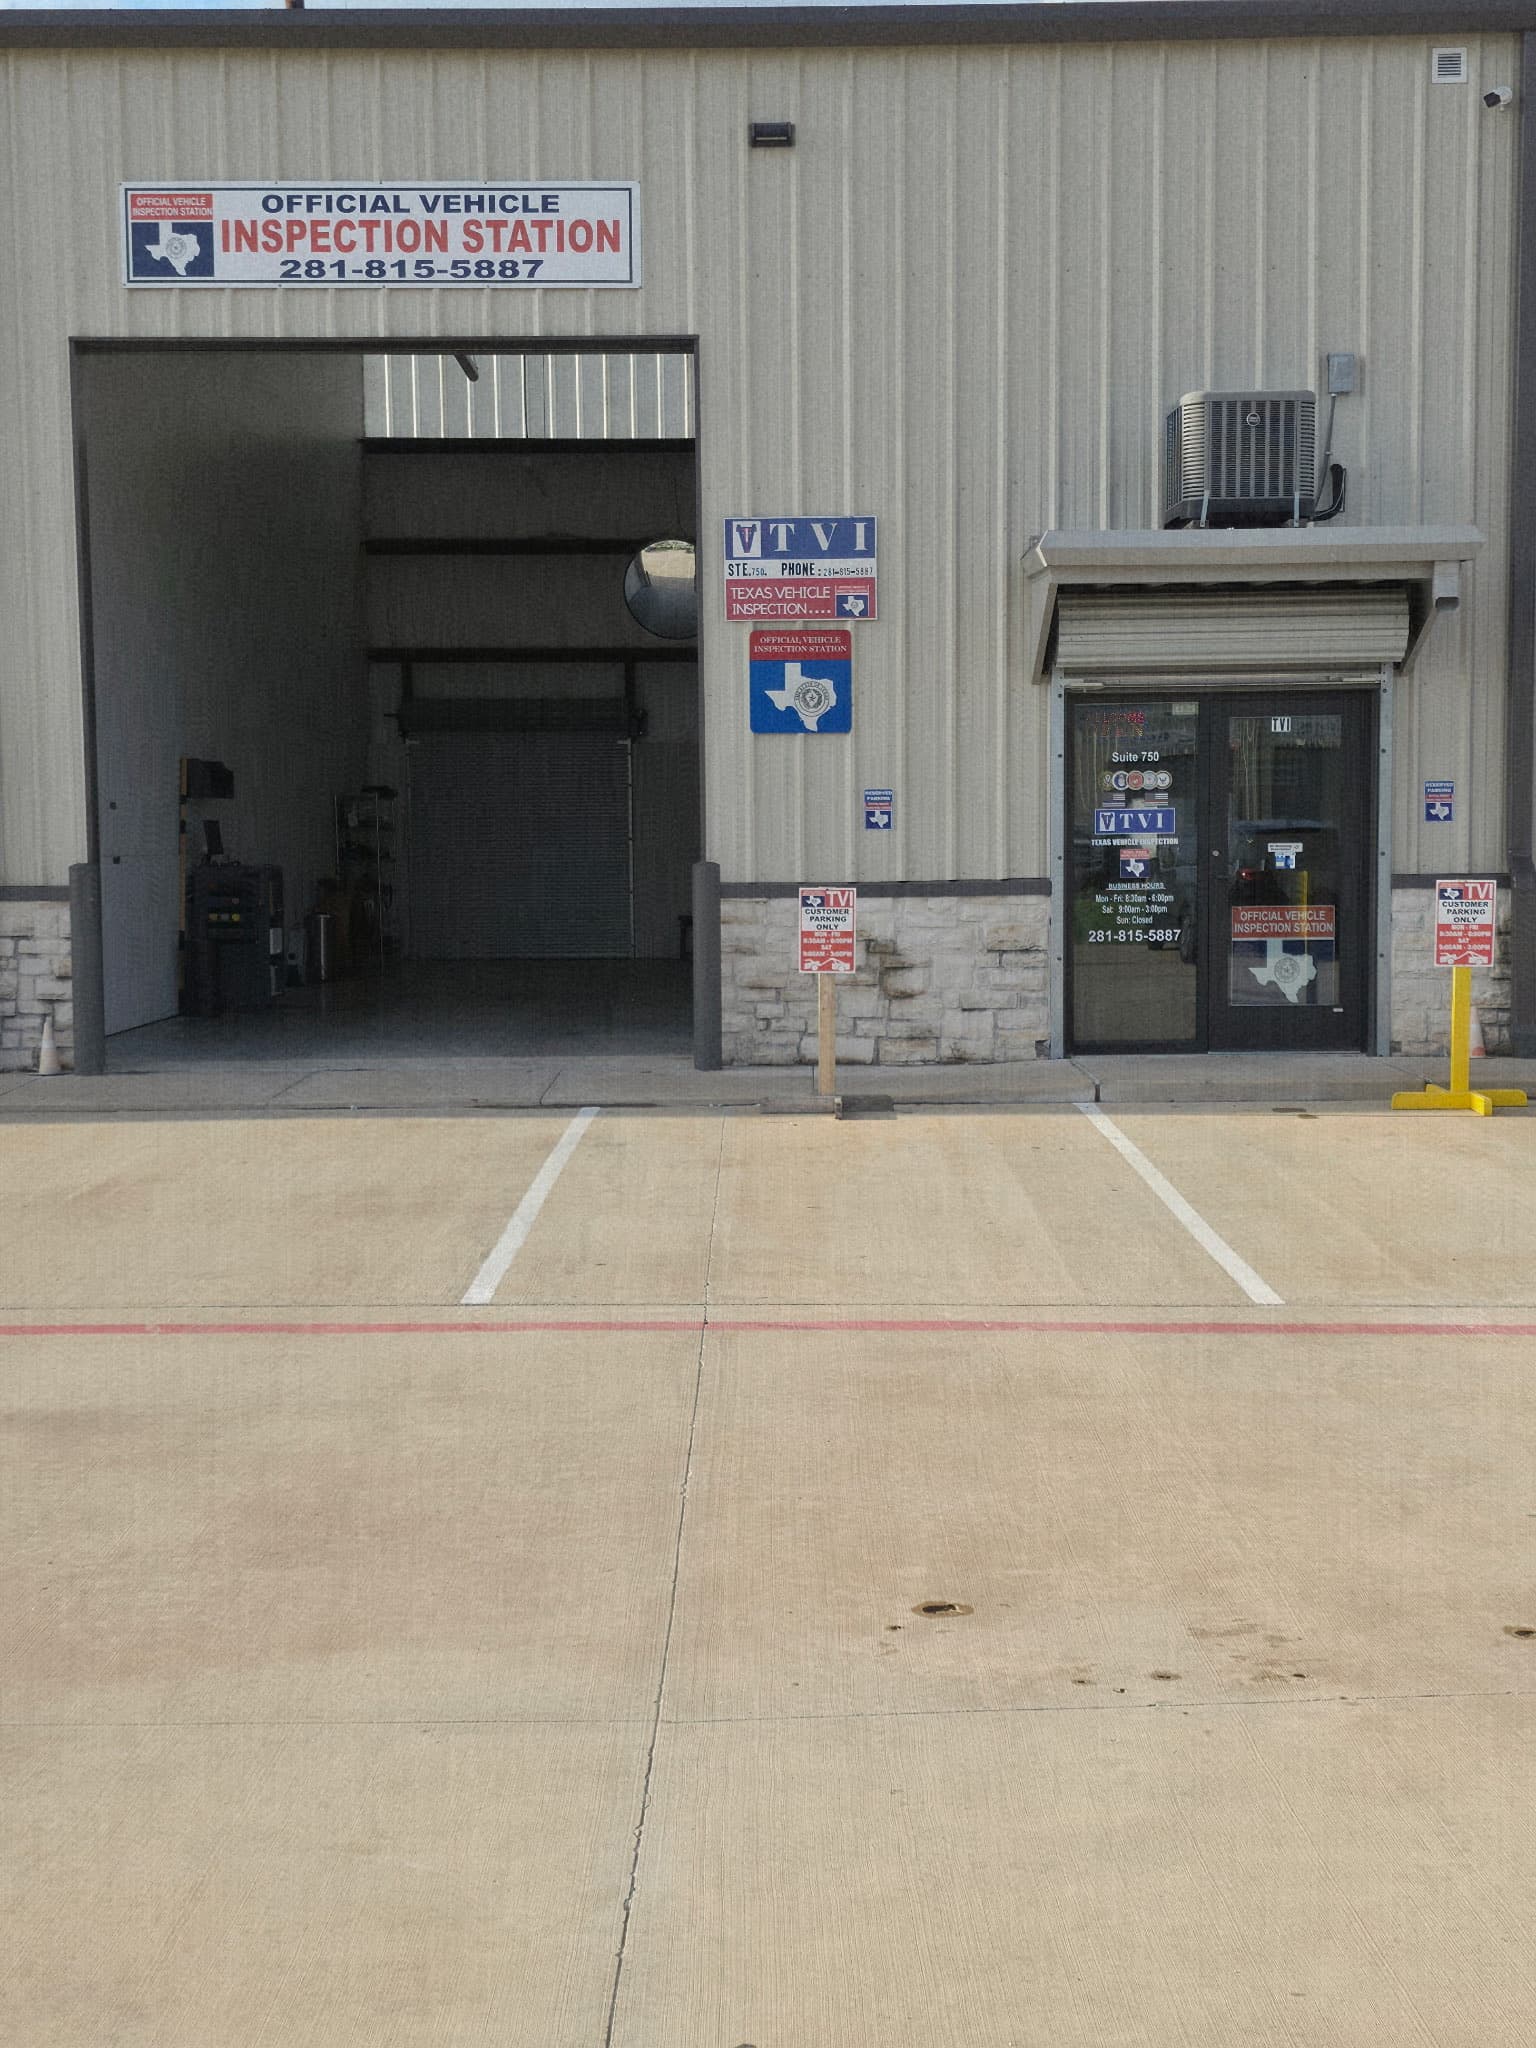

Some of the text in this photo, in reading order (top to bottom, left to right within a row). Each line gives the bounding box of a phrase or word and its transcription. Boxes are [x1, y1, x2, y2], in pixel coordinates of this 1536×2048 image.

[136, 197, 206, 206] OFFICIAL VEHICLE
[261, 194, 560, 214] OFFICIAL VEHICLE
[132, 207, 214, 216] INSPECTION STATION
[221, 219, 449, 253] INSPECTION
[462, 219, 621, 253] STATION
[279, 259, 544, 279] 281-815-5887
[730, 587, 772, 599] TEXAS
[775, 586, 831, 599] VEHICLE
[760, 636, 841, 644] OFFICIAL VEHICLE
[754, 645, 808, 653] INSPECTION
[1273, 718, 1290, 731] TVI
[1112, 752, 1160, 762] Suite 750
[1465, 883, 1494, 899] TVI
[826, 891, 853, 907] TVI
[1096, 894, 1108, 902] Mon
[1152, 894, 1174, 904] 6:00pm
[1118, 905, 1140, 913] 9:00am
[1145, 905, 1168, 914] 3:00pm
[1116, 916, 1153, 924] Sun: Closed
[1240, 911, 1326, 921] OFFICIAL VEHICLE
[1234, 923, 1333, 933] INSPECTION STATION
[1088, 930, 1182, 942] 281-815-5887
